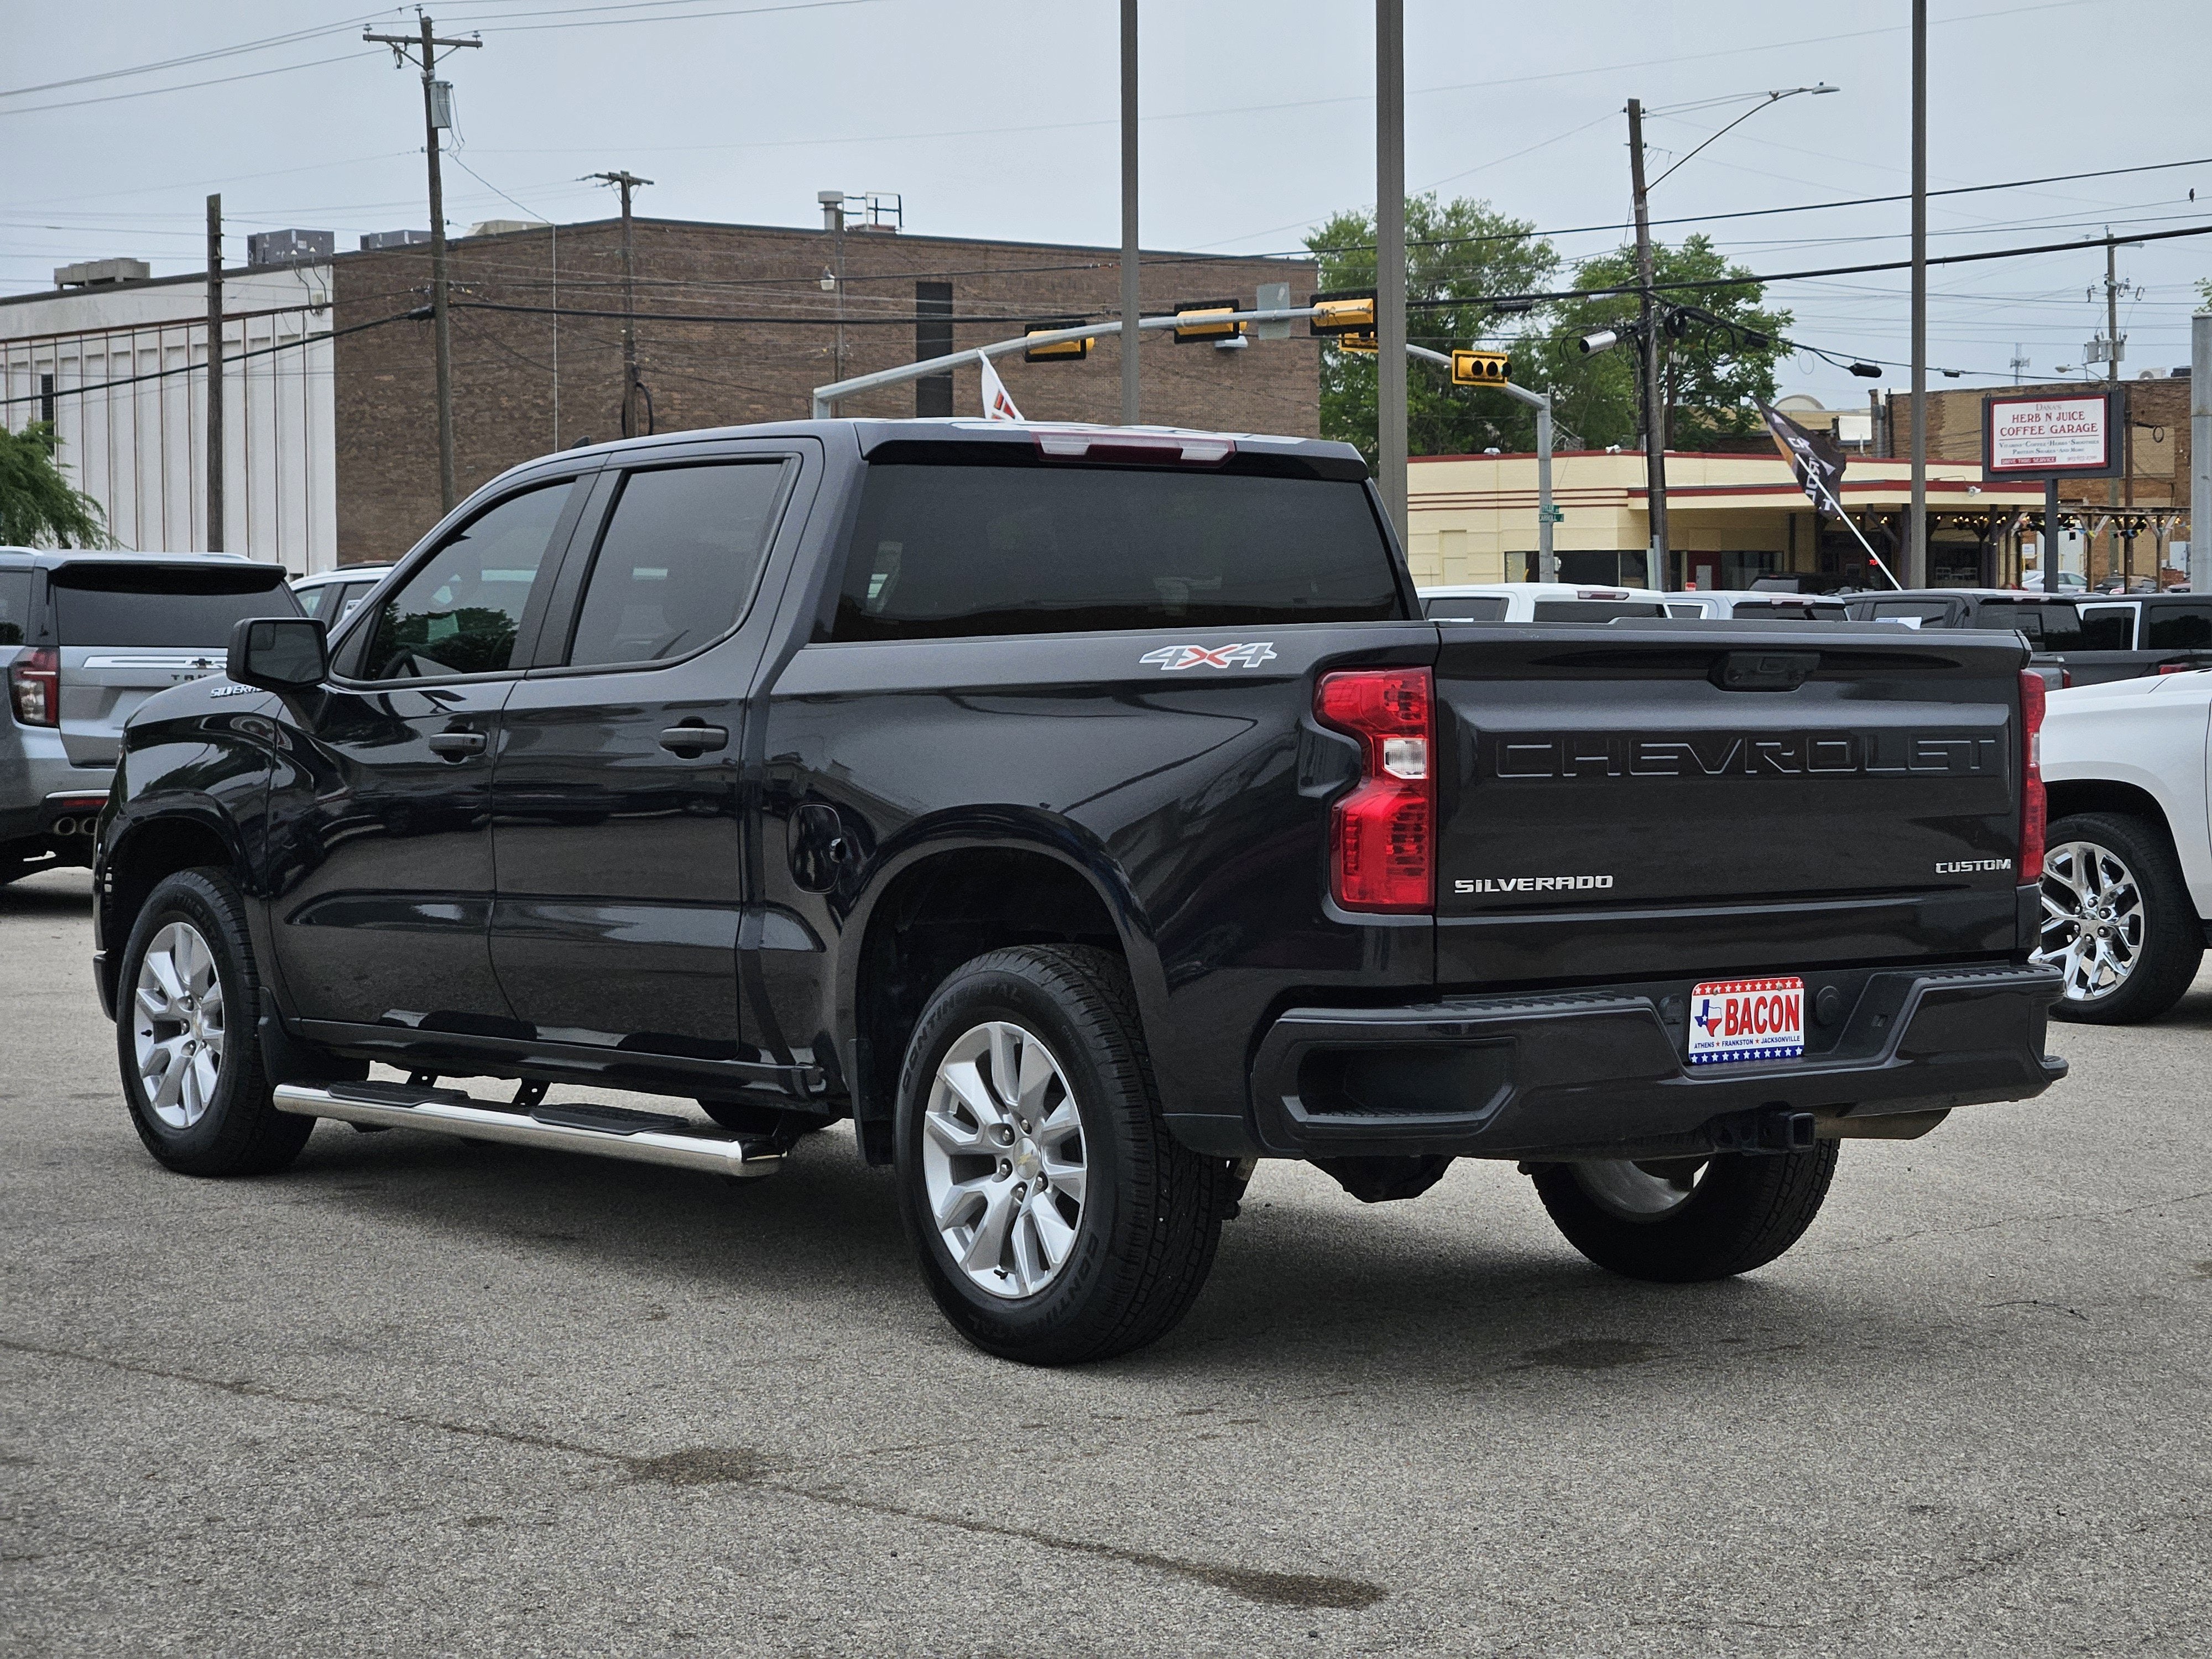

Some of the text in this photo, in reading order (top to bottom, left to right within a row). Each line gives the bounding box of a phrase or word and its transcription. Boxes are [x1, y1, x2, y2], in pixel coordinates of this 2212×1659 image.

[2012, 411, 2085, 424] HERB N JUICE
[2000, 423, 2098, 436] COFFEE GARAGE
[1496, 738, 1995, 777] CHEVROLET
[1936, 859, 2011, 874] CUSTOM
[1454, 875, 1614, 893] SILVERADO
[1725, 994, 1799, 1036] BACON
[1694, 1036, 1800, 1049] ATHENS FRANKSTON JACKSONVILLE
